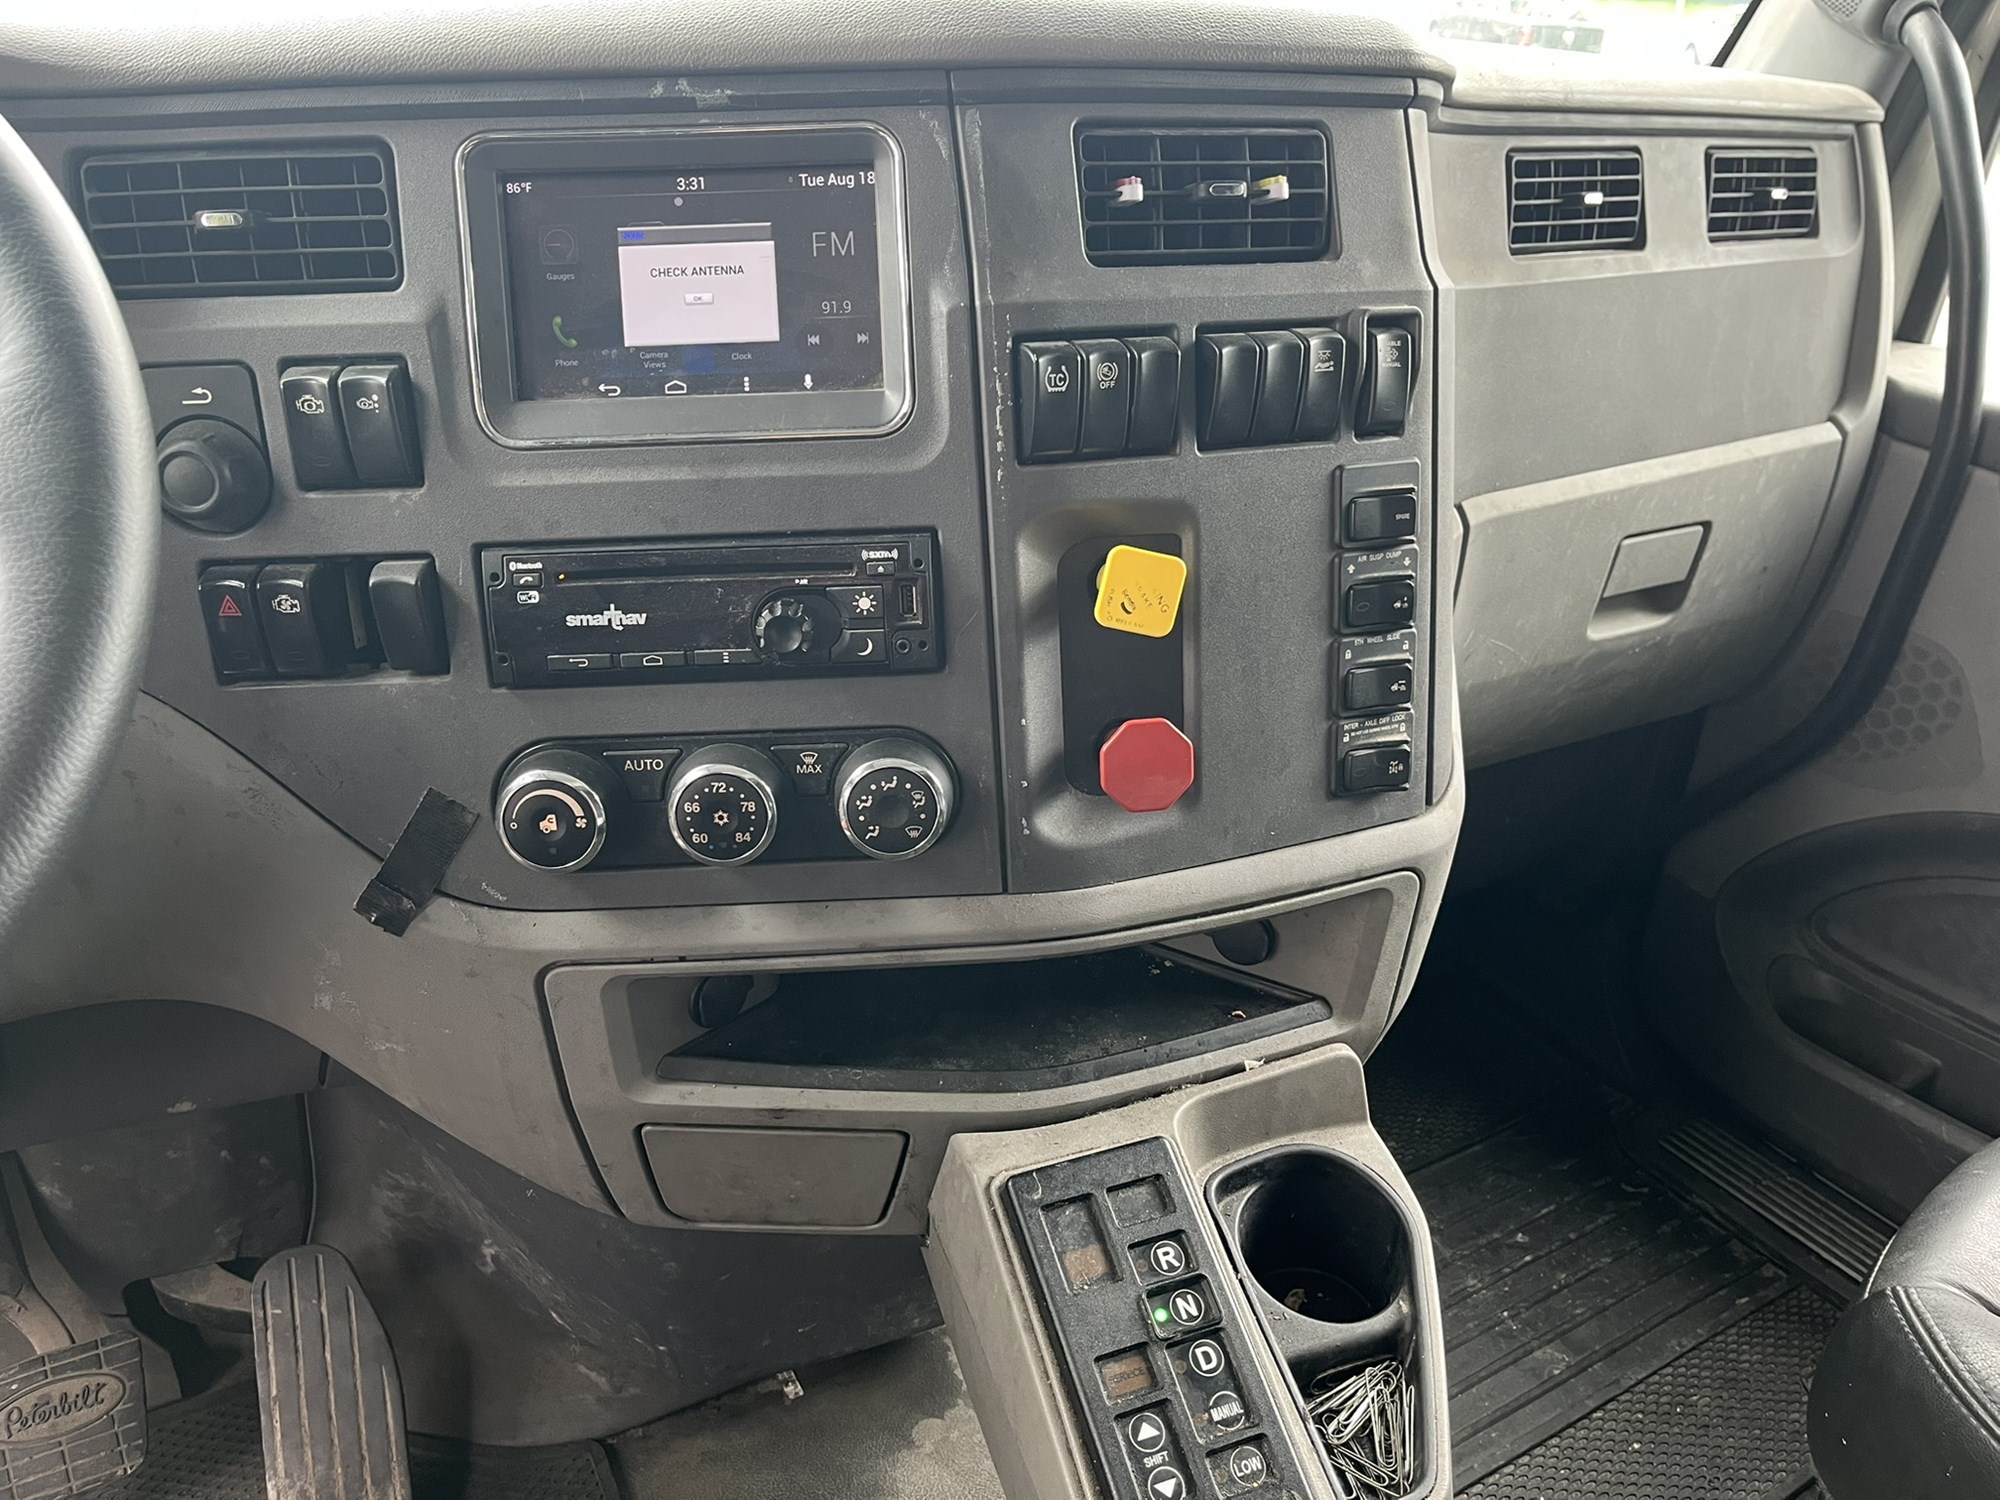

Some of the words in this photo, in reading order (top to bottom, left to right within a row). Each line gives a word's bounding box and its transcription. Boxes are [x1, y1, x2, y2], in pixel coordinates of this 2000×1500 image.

[676, 176, 705, 191] 3:31
[799, 173, 825, 187] Tue
[827, 172, 855, 189] Aug
[859, 171, 876, 185] 18
[506, 182, 532, 194] 86°F
[812, 230, 855, 257] FM
[546, 272, 575, 282] Gauges
[650, 266, 688, 279] CHECK
[691, 264, 745, 277] ANTENNA
[821, 300, 852, 314] 91.9
[639, 351, 669, 359] Camera
[731, 352, 753, 360] Clock
[555, 359, 579, 367] Phone
[643, 361, 667, 369] Views
[1049, 373, 1065, 387] TC
[1099, 381, 1116, 389] OFF
[565, 603, 647, 631] smartnav
[1343, 722, 1359, 731] INTER
[1364, 719, 1378, 727] AXLE
[1379, 716, 1391, 724] DIFF
[1392, 714, 1406, 722] LOCK
[624, 759, 664, 771] AUTO
[796, 764, 822, 774] MAX
[710, 782, 727, 793] 72
[683, 801, 700, 813] 66
[740, 801, 756, 813] 78
[691, 833, 708, 844] 60
[735, 832, 751, 843] 84
[1156, 1246, 1181, 1271] R
[1175, 1294, 1199, 1320] N
[1194, 1345, 1218, 1371] D
[5, 1382, 107, 1440] Peterbilt
[1210, 1401, 1244, 1422] MANUAL
[1143, 1450, 1169, 1468] SHIFT
[1233, 1455, 1262, 1477] LOW
